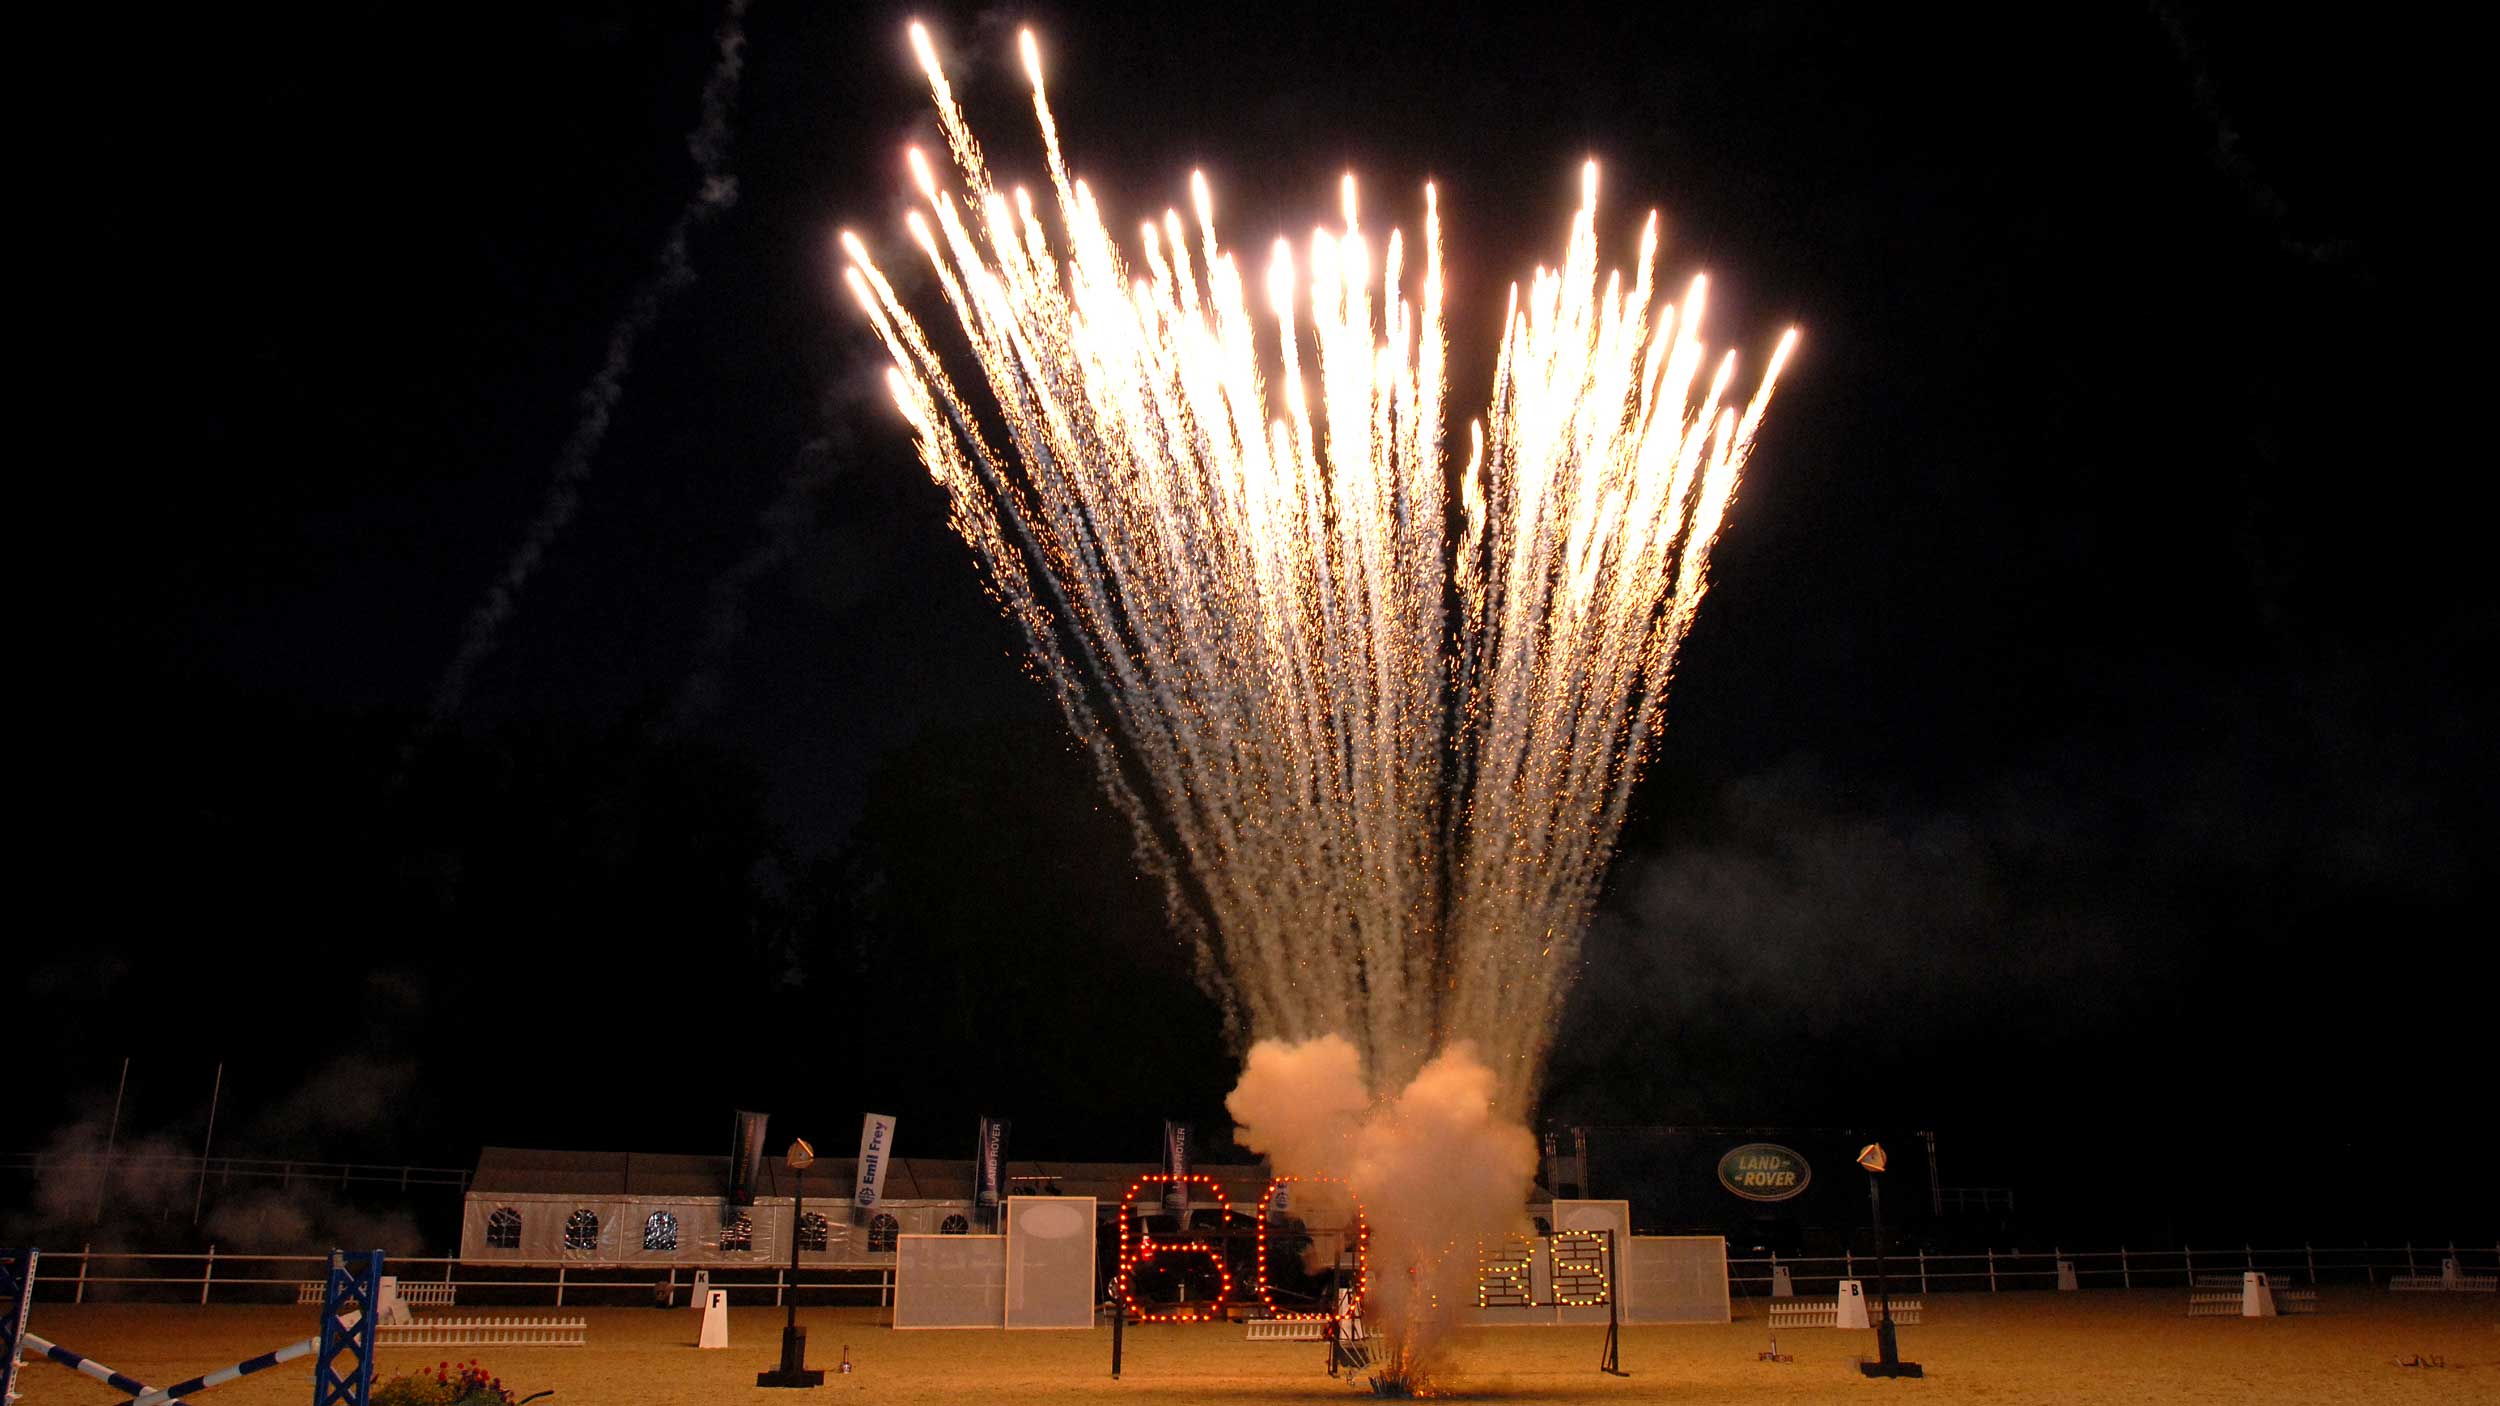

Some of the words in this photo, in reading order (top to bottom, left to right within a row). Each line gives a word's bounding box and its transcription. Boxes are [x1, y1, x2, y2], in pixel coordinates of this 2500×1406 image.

[869, 1121, 888, 1152] Frey
[990, 1123, 1001, 1158] ROVER
[863, 1154, 879, 1185] Emil
[987, 1160, 998, 1187] LAND
[698, 1273, 706, 1283] K
[1851, 1283, 1859, 1296] B
[712, 1293, 721, 1308] F
